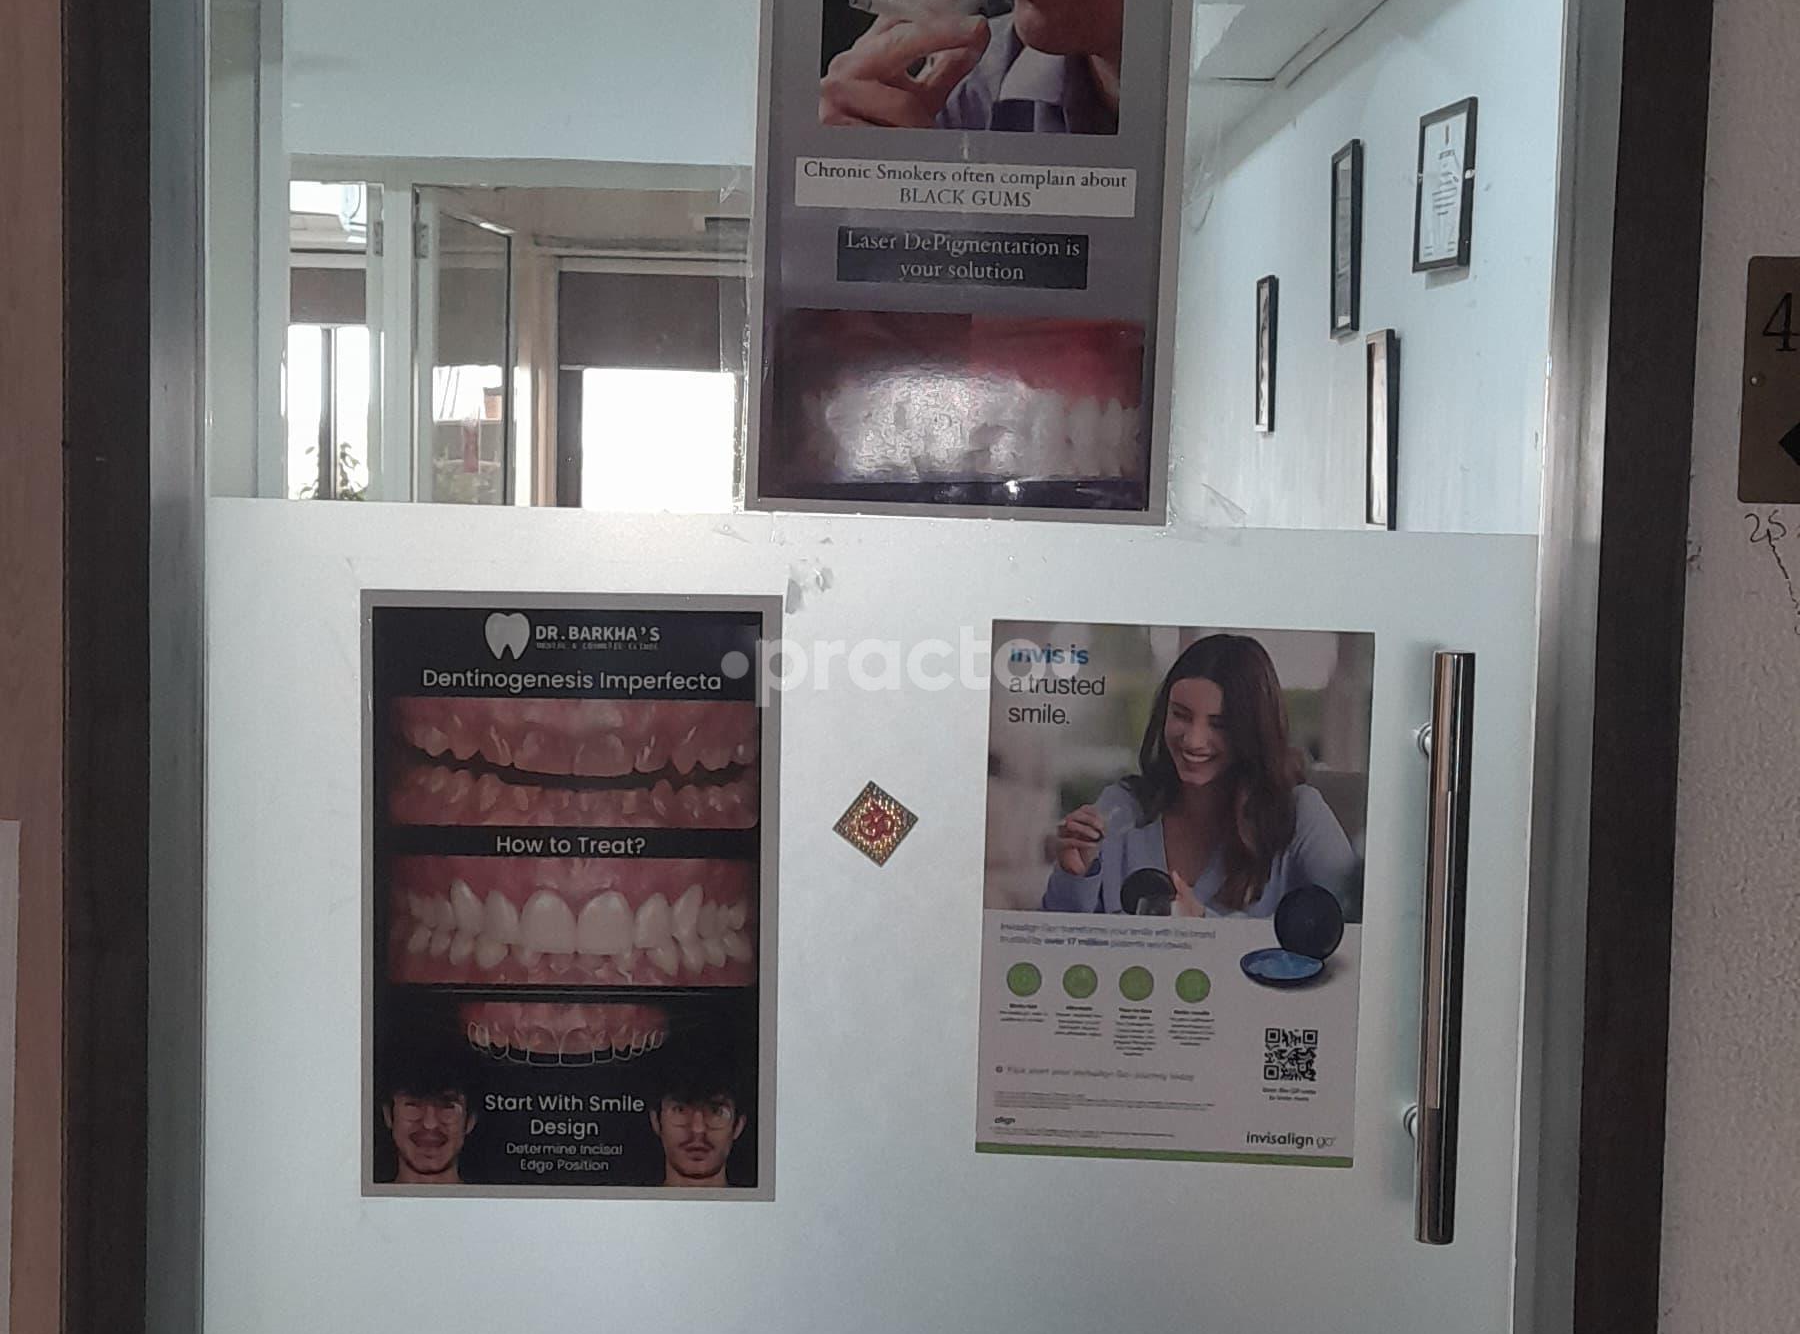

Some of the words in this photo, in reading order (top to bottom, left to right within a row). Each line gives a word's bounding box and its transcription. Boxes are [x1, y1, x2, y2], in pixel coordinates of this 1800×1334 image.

[803, 160, 871, 180] Chronic
[876, 163, 947, 182] Smokers
[951, 165, 995, 184] often
[1000, 168, 1076, 190] complain
[1080, 171, 1128, 188] about
[899, 187, 965, 205] BLACK
[971, 189, 1032, 208] GUMS
[846, 229, 897, 250] Laser
[903, 232, 1060, 259] DePigmentation
[1065, 238, 1081, 256] is
[899, 263, 943, 282] your
[948, 260, 1025, 281] solution
[1070, 643, 1089, 665] is
[422, 669, 593, 694] Dentinogenesis
[599, 671, 722, 695] Imperfecta
[1008, 676, 1023, 693] a
[1028, 674, 1105, 696] trusted
[1008, 702, 1071, 725] smile.
[496, 835, 545, 854] How
[550, 837, 571, 854] to
[578, 836, 646, 855] Treat?
[484, 1094, 533, 1111] Start
[538, 1094, 584, 1112] With
[589, 1095, 645, 1113] Smile
[530, 1118, 599, 1140] Design
[506, 1142, 577, 1155] Determine
[580, 1143, 623, 1156] Incisal
[1246, 1132, 1314, 1149] invisalign
[557, 1158, 609, 1172] Position
